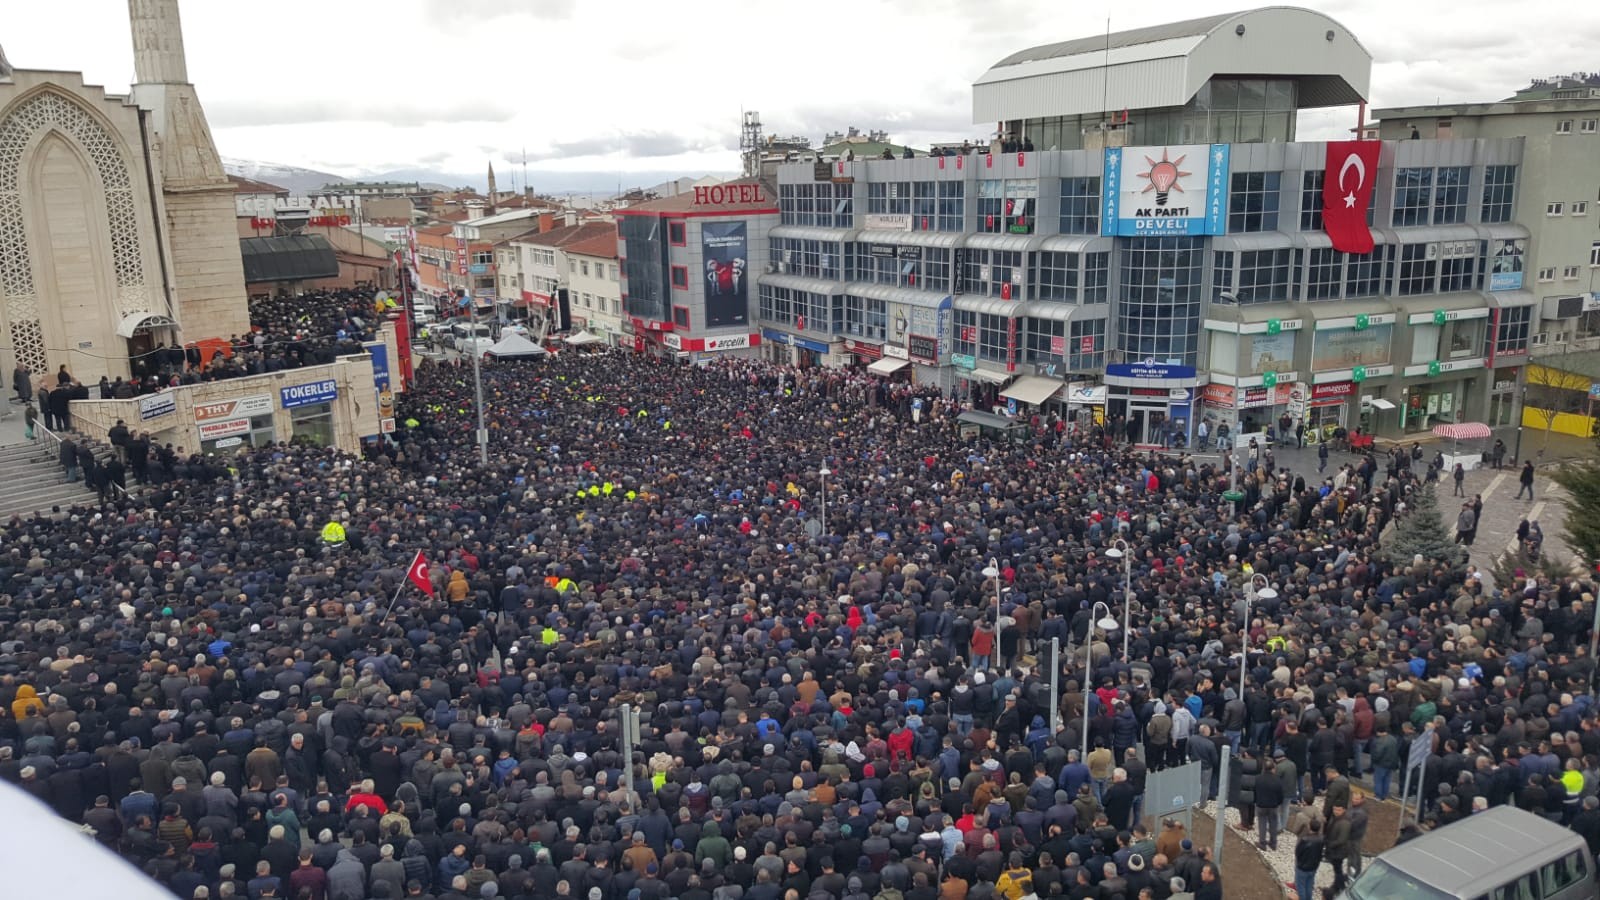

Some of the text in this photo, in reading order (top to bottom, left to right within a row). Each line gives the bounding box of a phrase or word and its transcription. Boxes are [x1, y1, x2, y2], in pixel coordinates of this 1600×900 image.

[694, 184, 765, 205] HOTEL
[1136, 208, 1152, 216] AK
[1136, 219, 1188, 229] DEVELİ
[282, 381, 336, 400] TOKERLER
[205, 403, 229, 414] THY
